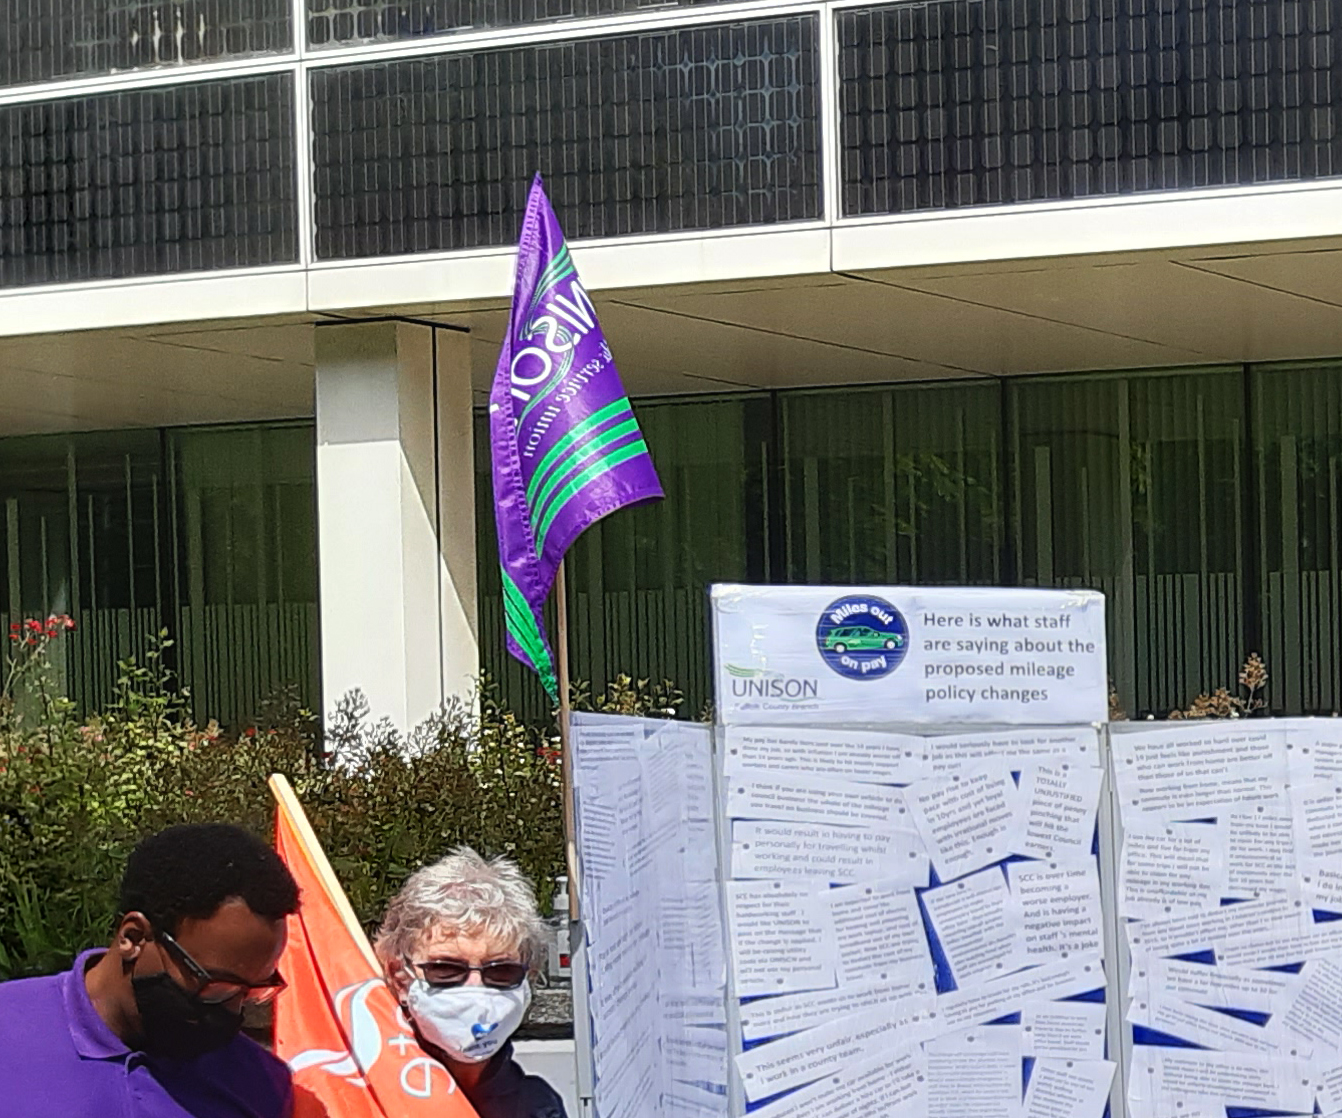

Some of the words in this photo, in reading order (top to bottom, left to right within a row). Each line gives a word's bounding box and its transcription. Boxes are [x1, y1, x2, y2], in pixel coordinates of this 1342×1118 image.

[830, 604, 868, 624] Miles
[871, 606, 894, 625] out
[924, 613, 963, 627] Here
[970, 613, 981, 627] is
[987, 614, 1029, 628] what
[1034, 615, 1071, 628] staff
[924, 640, 951, 650] are
[957, 637, 1009, 655] saying
[1014, 638, 1063, 652] about
[1068, 639, 1095, 653] the
[842, 655, 858, 669] on
[861, 655, 886, 673] pay
[925, 662, 1004, 678] proposed
[1010, 662, 1075, 679] mileage
[732, 679, 818, 698] UNISON
[926, 685, 976, 703] policy
[981, 686, 1048, 703] changes
[1020, 885, 1061, 894] becoming
[1336, 883, 1342, 891] in
[1316, 894, 1328, 902] my
[1051, 906, 1079, 915] having
[1025, 921, 1061, 930] negative
[1063, 918, 1090, 926] impact
[1040, 932, 1058, 940] staff
[1069, 928, 1098, 937] mental
[1081, 941, 1098, 950] joke
[755, 1064, 774, 1073] This
[776, 1053, 803, 1068] seems
[807, 1045, 825, 1057] very
[855, 1021, 897, 1040] especially
[767, 1071, 787, 1082] work
[789, 1066, 798, 1075] in
[808, 1055, 837, 1069] county
